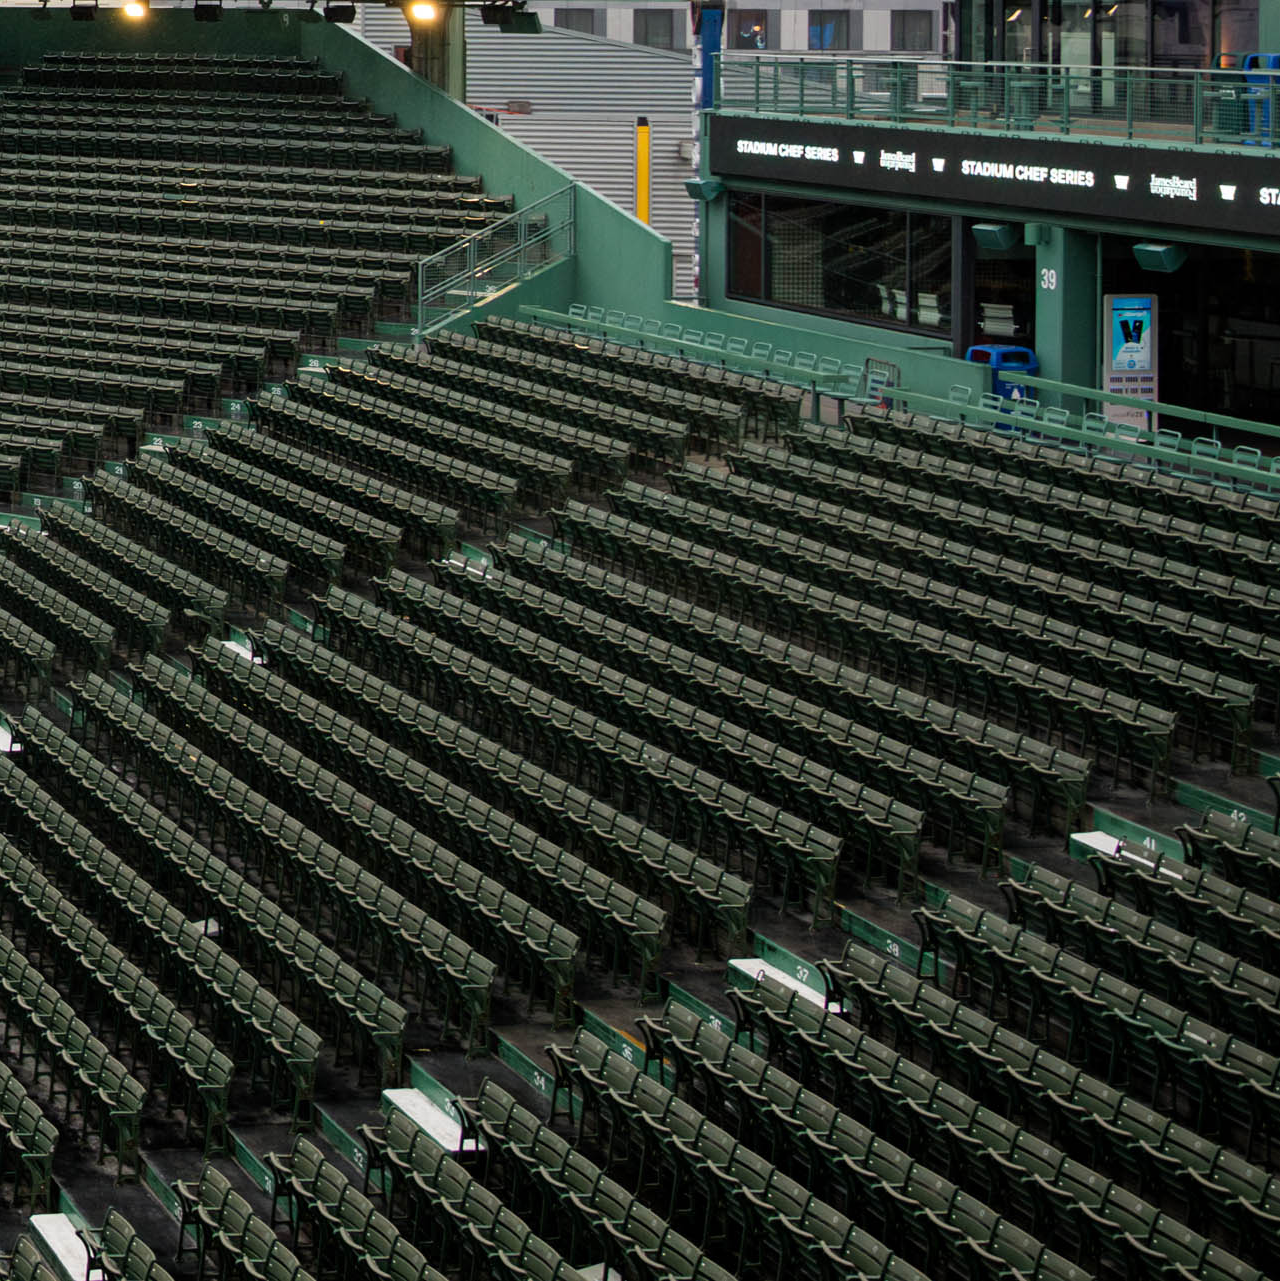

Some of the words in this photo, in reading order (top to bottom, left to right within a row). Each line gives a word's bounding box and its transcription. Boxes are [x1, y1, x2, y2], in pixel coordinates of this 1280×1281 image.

[736, 139, 778, 156] STADIUM
[779, 142, 804, 159] CHEF
[804, 145, 839, 162] SERIES
[961, 163, 1014, 180] STADIUM
[1015, 166, 1047, 182] CHEF
[1049, 169, 1095, 187] SERIES
[1259, 187, 1280, 206] ST
[1041, 268, 1057, 291] 39
